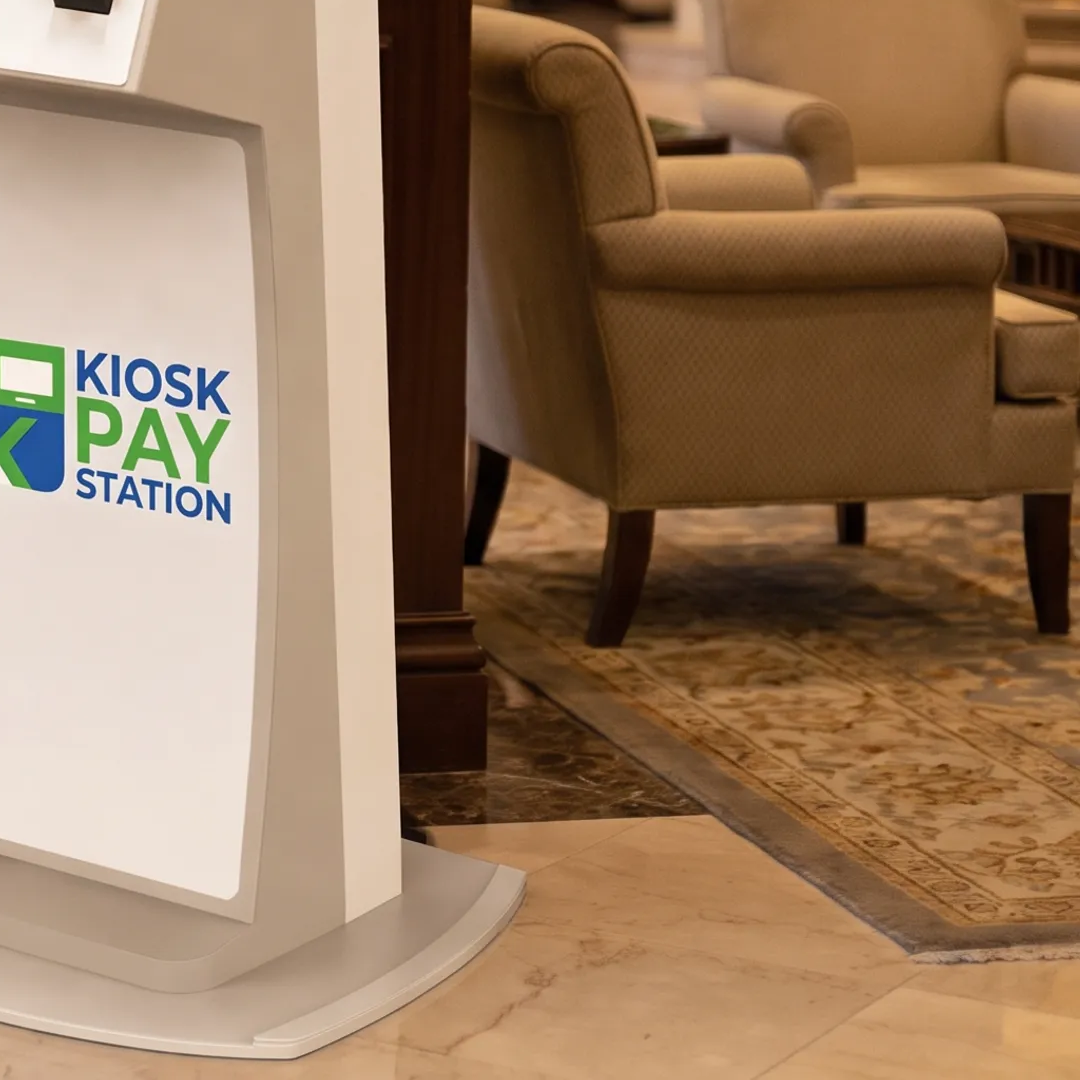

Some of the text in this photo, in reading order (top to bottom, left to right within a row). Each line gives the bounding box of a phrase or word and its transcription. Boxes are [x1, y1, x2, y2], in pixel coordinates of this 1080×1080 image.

[76, 349, 231, 415] KIOSK
[76, 396, 231, 484] PAY
[76, 467, 231, 524] STATION
